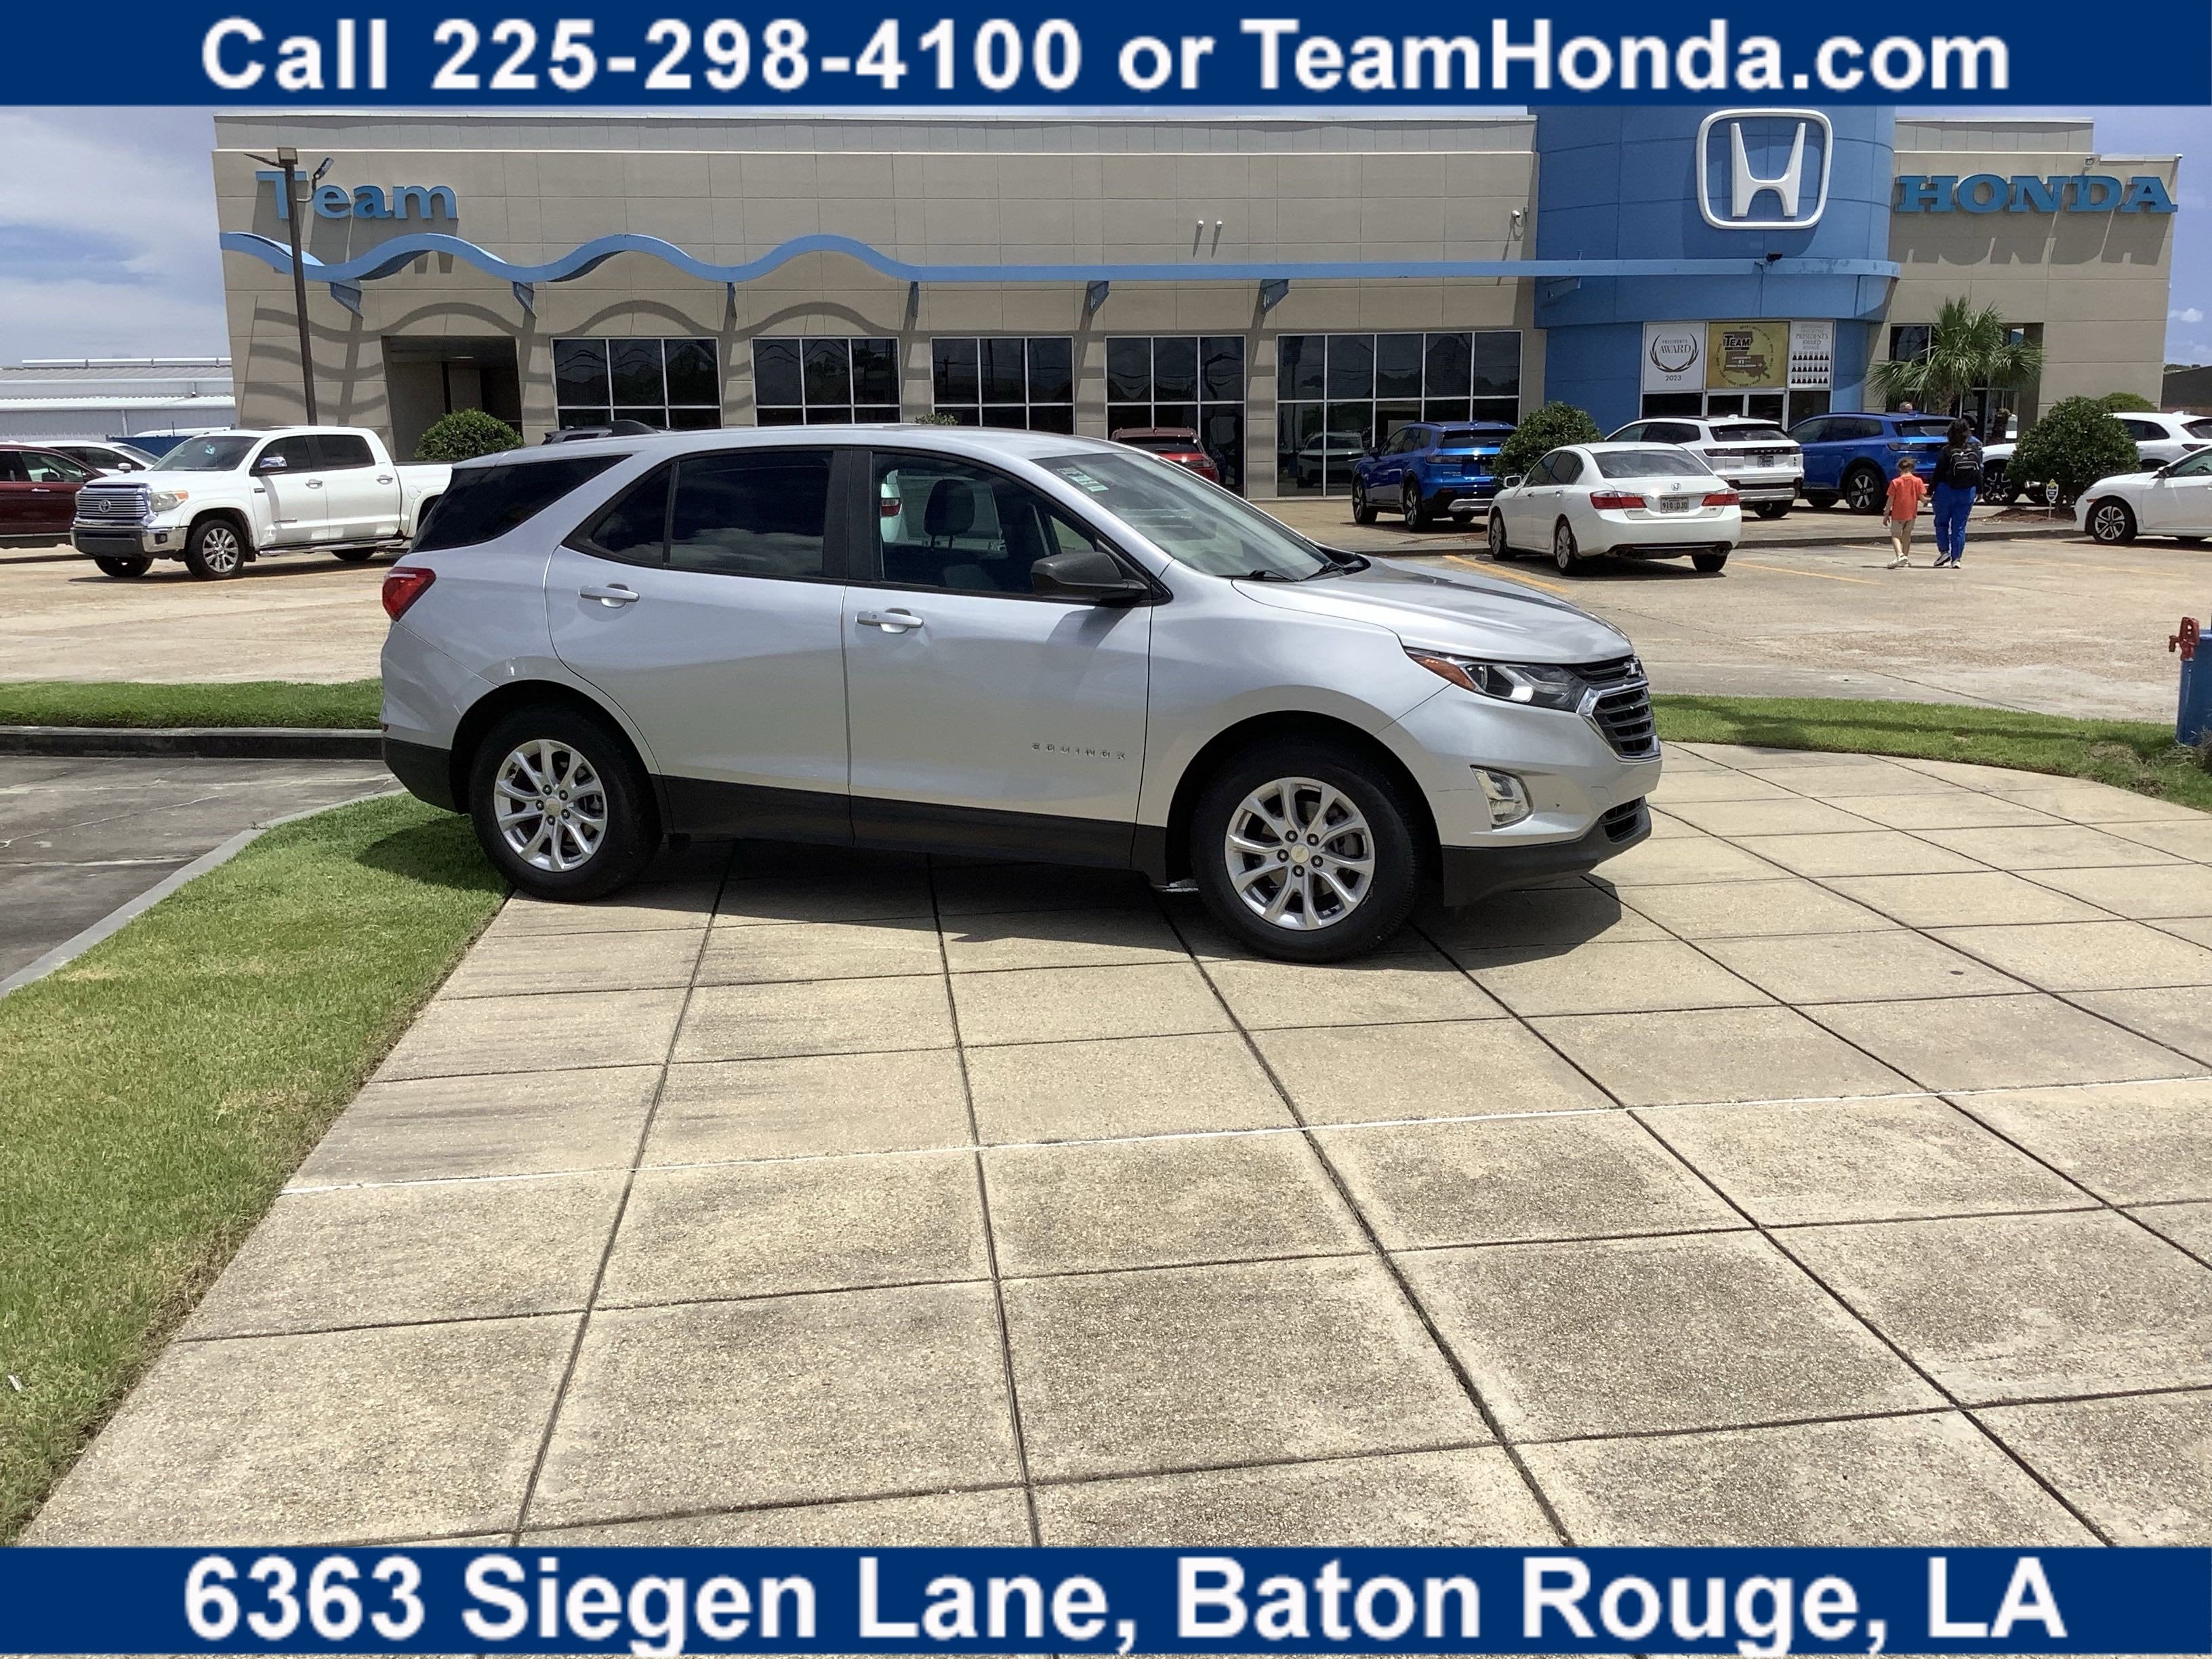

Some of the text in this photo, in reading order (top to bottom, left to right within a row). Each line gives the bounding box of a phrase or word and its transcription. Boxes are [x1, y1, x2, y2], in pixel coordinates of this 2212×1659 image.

[255, 171, 457, 220] Team
[1896, 173, 2178, 213] HONDA
[1660, 344, 1692, 354] AWARD
[1723, 334, 1751, 347] TEAM
